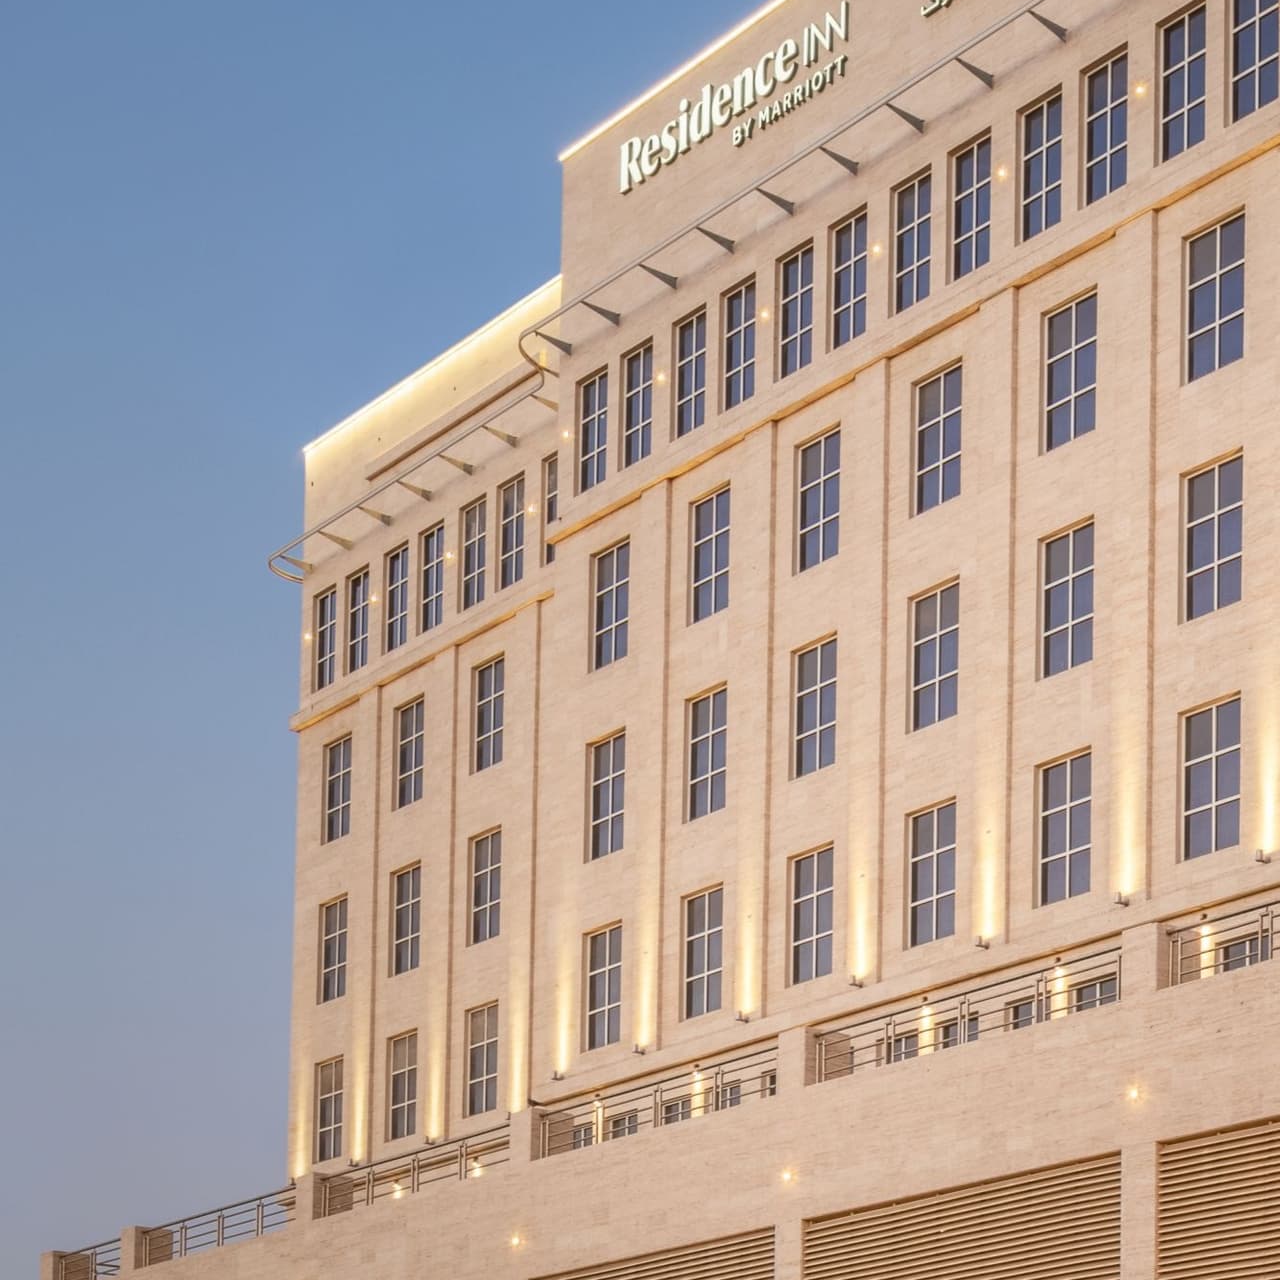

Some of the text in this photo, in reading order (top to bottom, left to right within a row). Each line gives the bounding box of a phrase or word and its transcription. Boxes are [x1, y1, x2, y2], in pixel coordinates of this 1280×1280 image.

[619, 0, 849, 194] Residence INN
[732, 54, 849, 147] BY MARRIOTT
